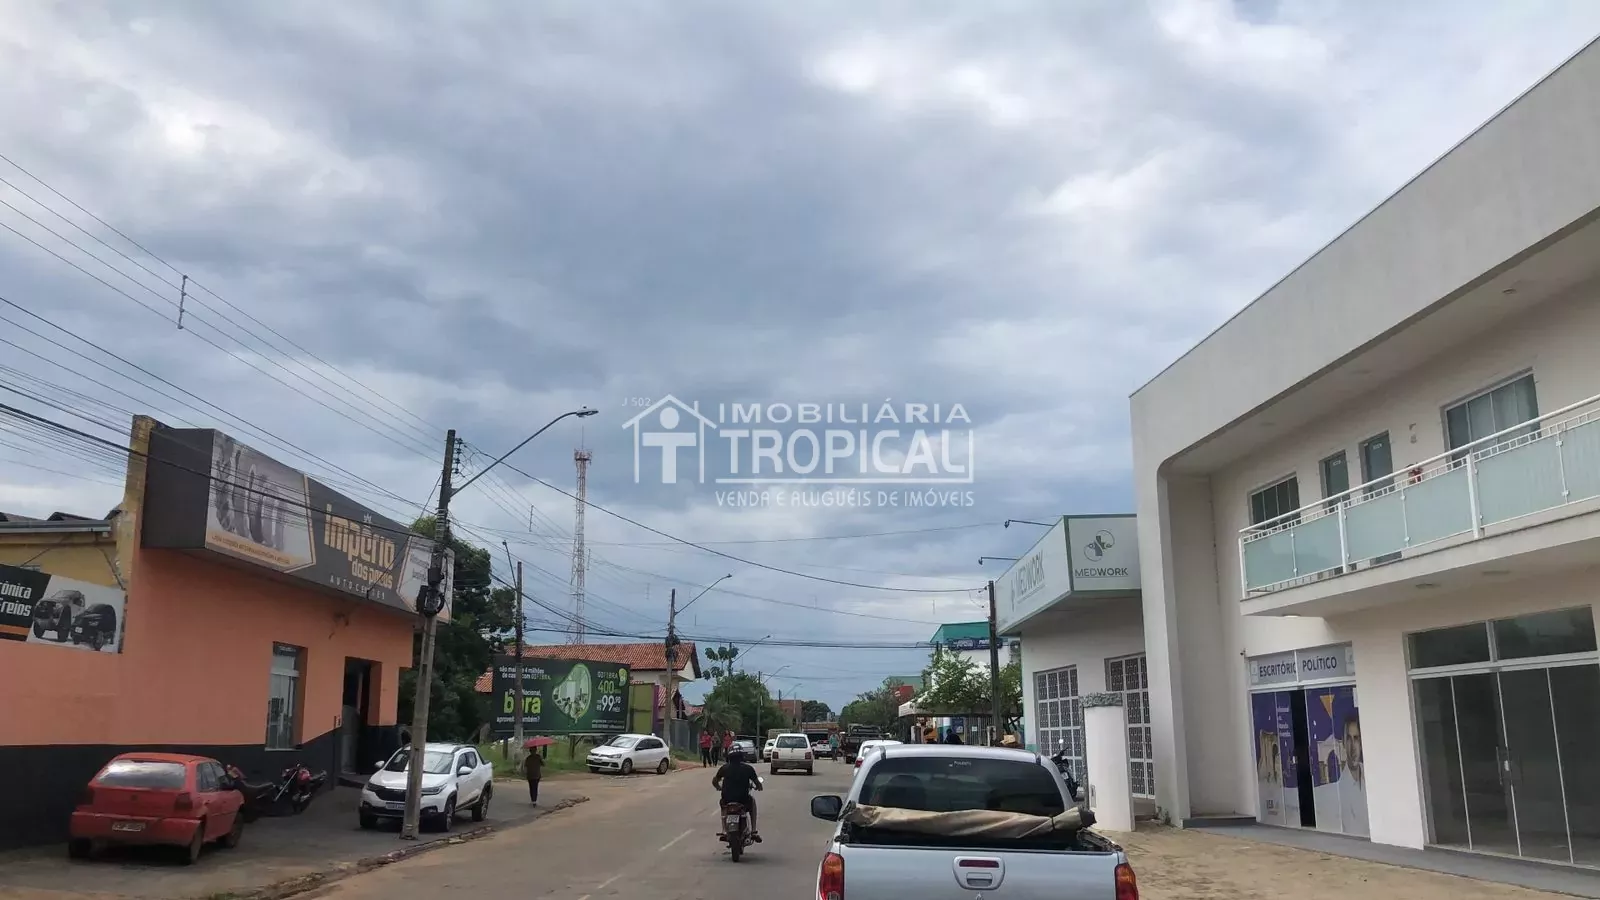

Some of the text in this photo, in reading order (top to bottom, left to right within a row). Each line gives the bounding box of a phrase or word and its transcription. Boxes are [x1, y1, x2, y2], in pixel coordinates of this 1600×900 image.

[1074, 567, 1129, 577] MEDWORK
[1302, 655, 1337, 672] POLÍTICO
[597, 680, 615, 694] 400
[503, 690, 541, 714] bra
